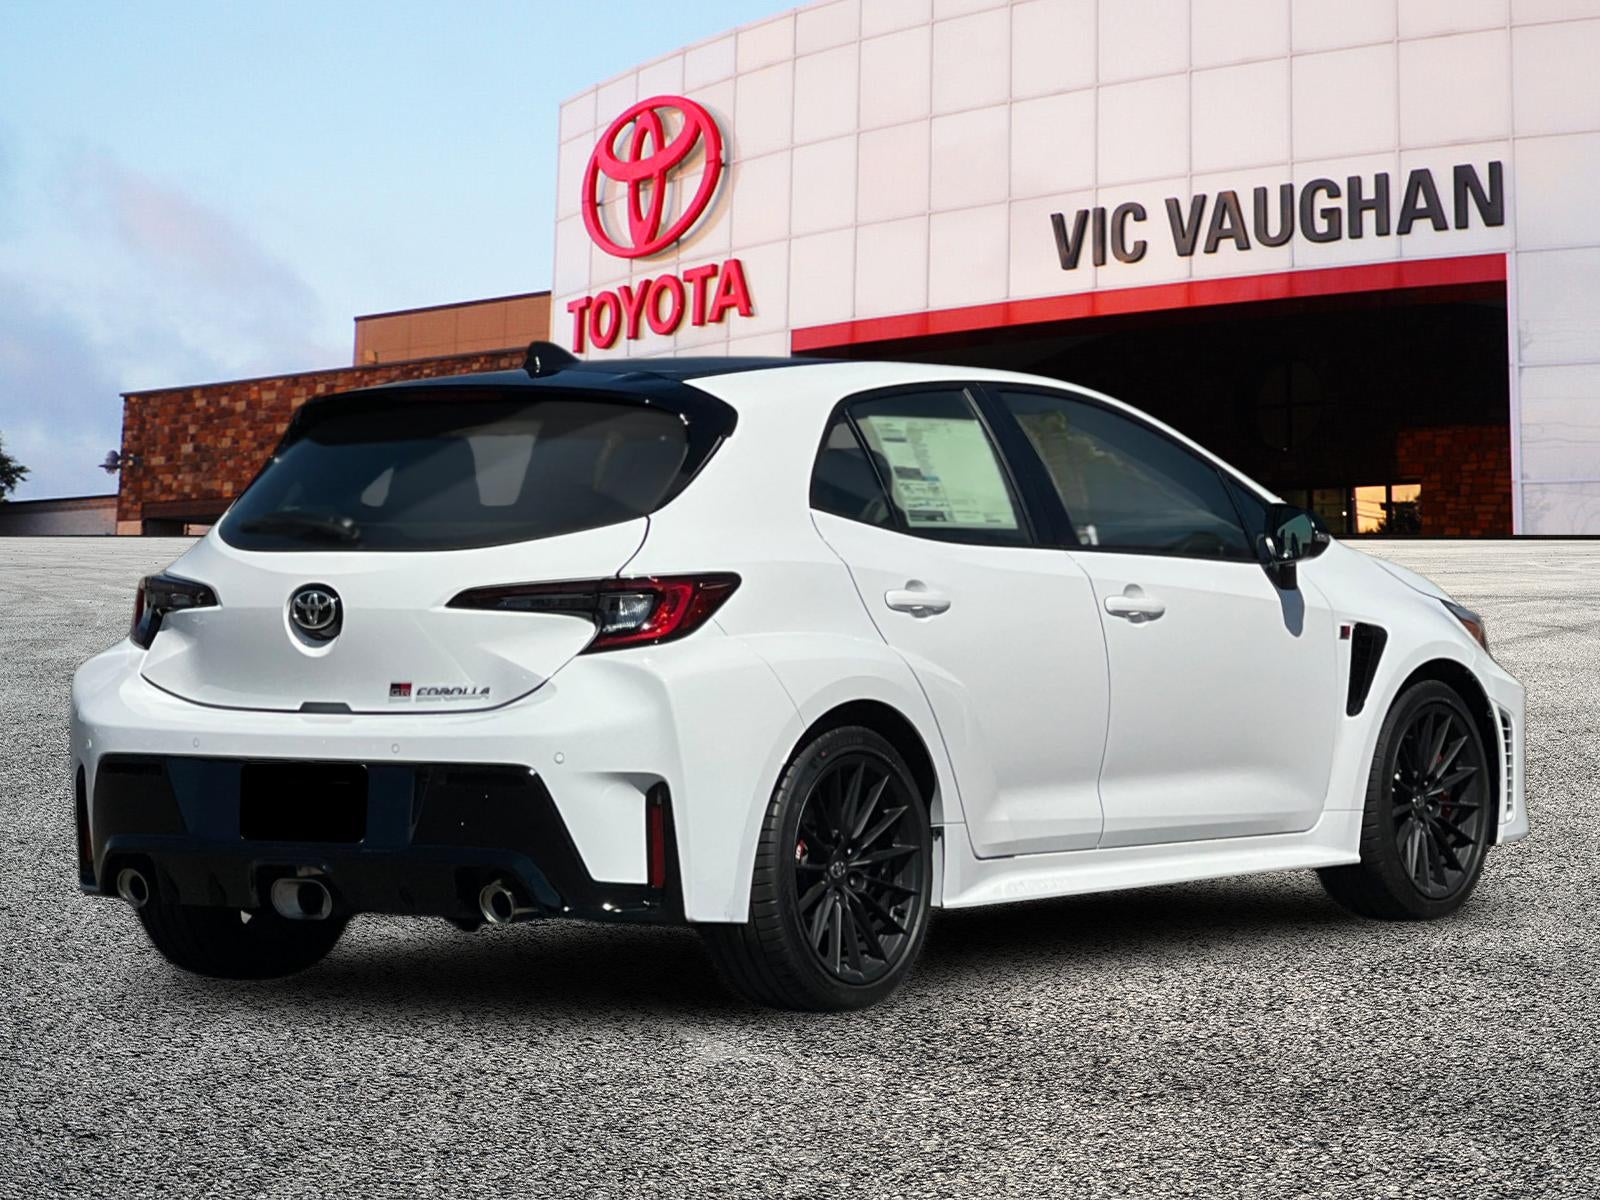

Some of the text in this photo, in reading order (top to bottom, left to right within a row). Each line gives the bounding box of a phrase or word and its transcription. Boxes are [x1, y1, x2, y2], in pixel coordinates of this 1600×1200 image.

[1050, 161, 1504, 270] VIC VAUGHAN
[567, 259, 753, 353] TOYOTA
[416, 687, 490, 700] COROLLA
